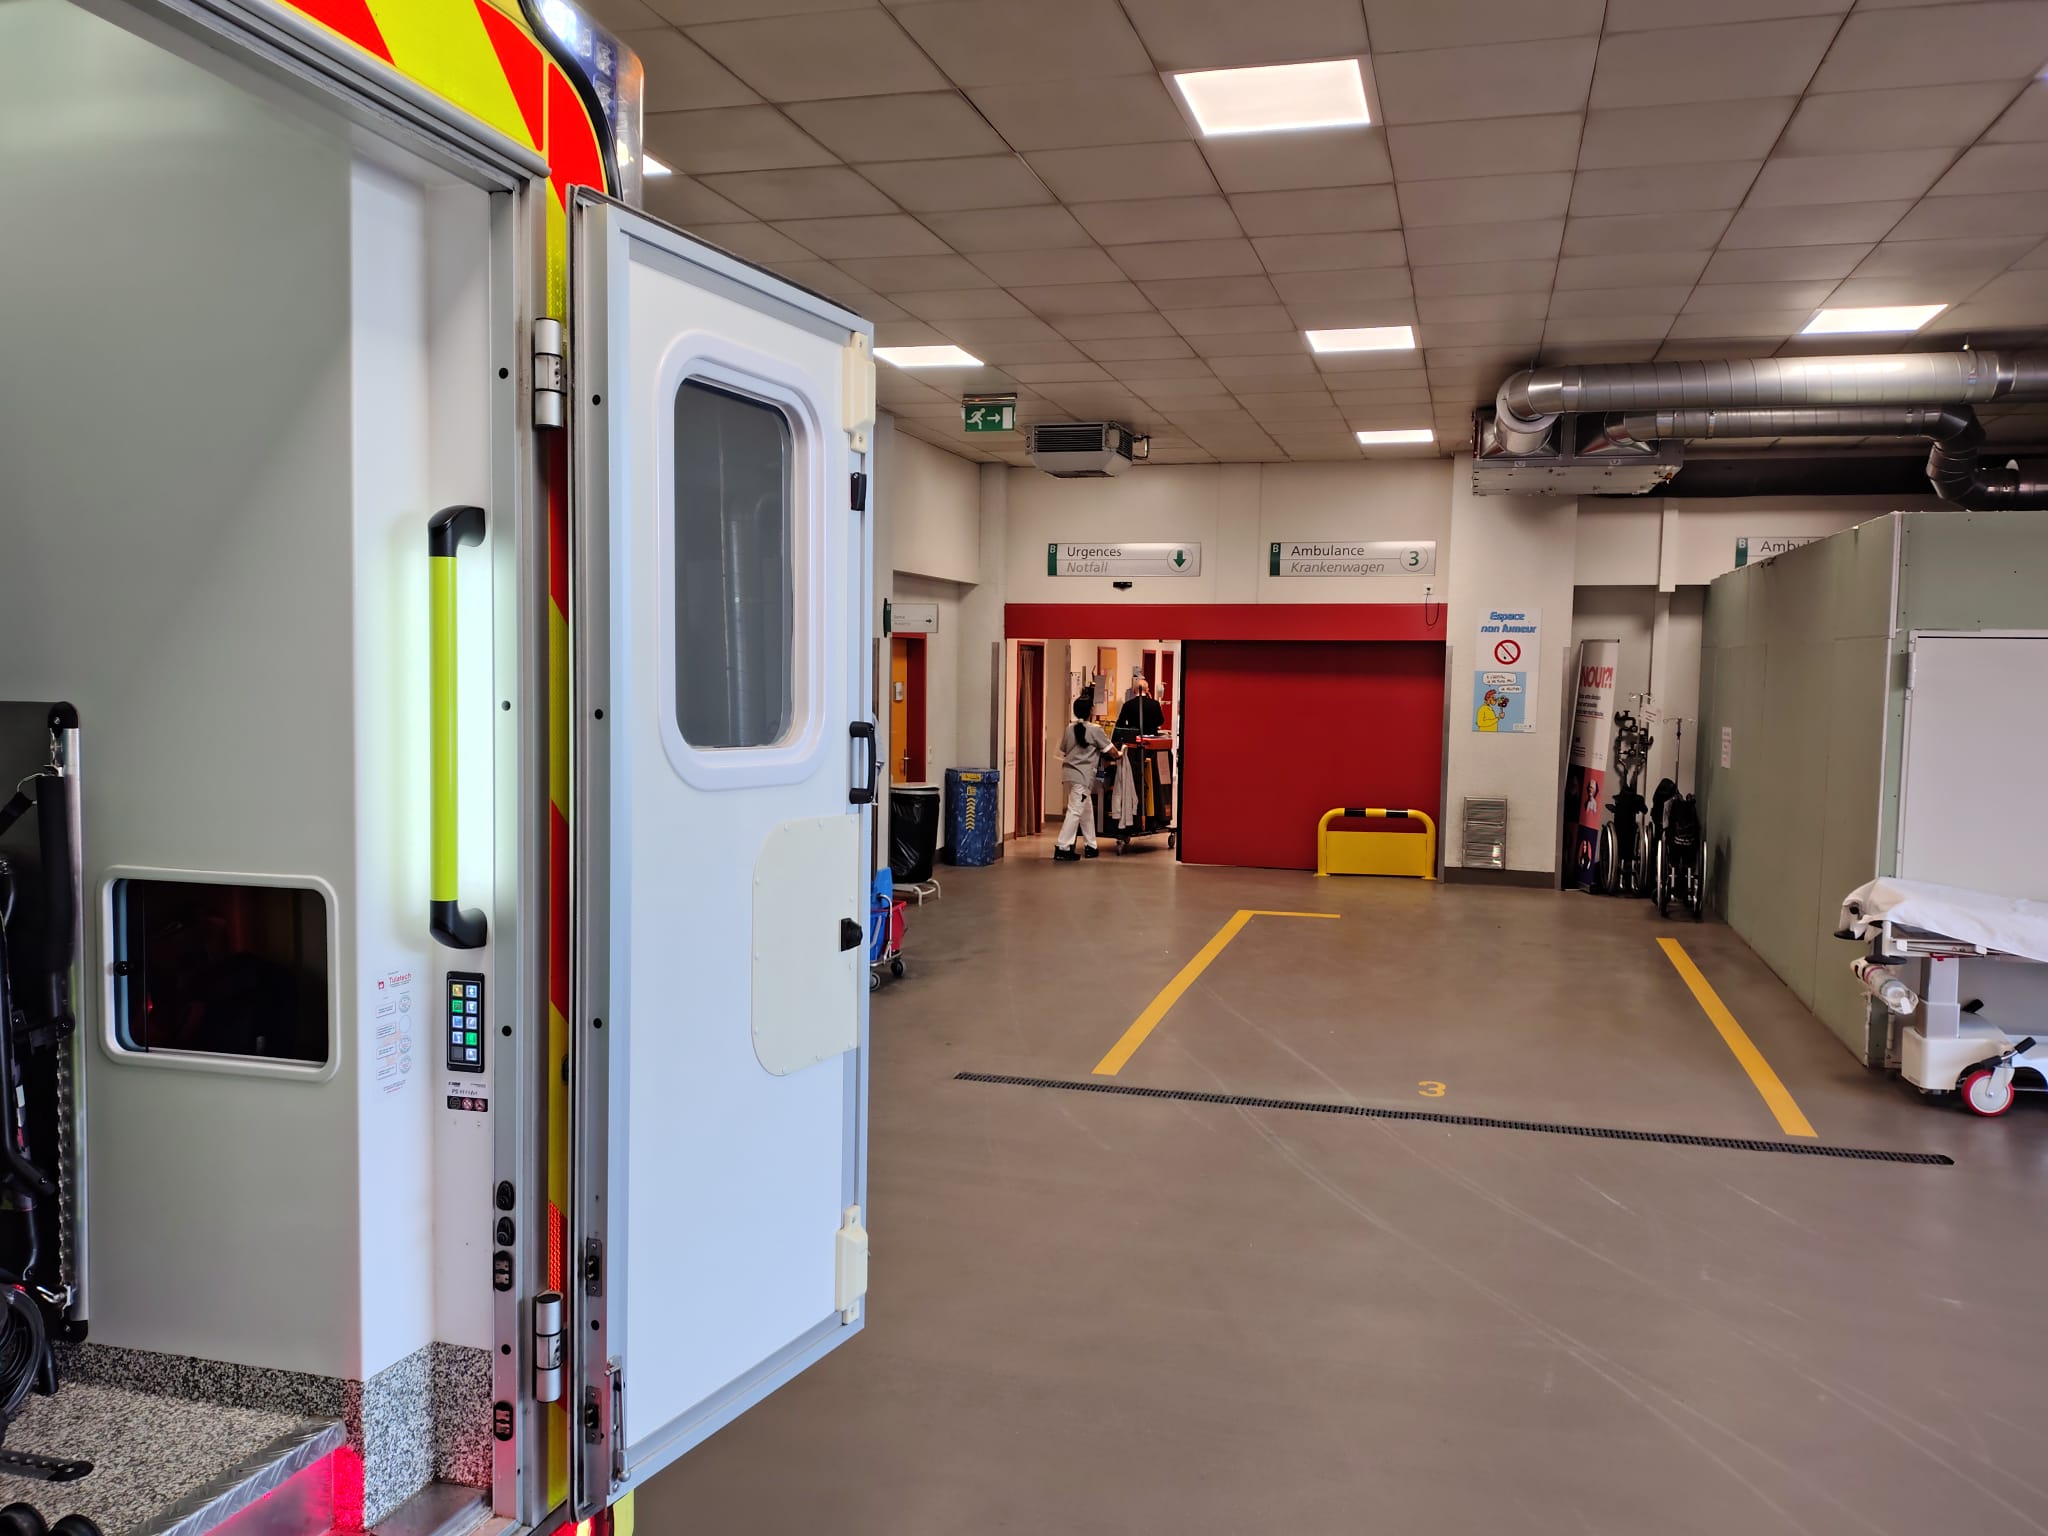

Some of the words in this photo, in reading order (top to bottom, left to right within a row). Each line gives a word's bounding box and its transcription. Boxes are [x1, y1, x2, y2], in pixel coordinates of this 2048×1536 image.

[1050, 545, 1056, 553] B
[1272, 544, 1279, 553] B
[1739, 539, 1747, 548] B
[1067, 546, 1122, 560] Urgences
[1290, 545, 1365, 556] Ambulance
[1408, 551, 1420, 566] 3
[1066, 562, 1109, 573] Notfall
[1290, 561, 1385, 575] Krankenwagen
[1490, 611, 1525, 622] Espace
[1481, 625, 1500, 633] non
[1502, 623, 1537, 633] fumeur
[1418, 1080, 1447, 1097] 3
